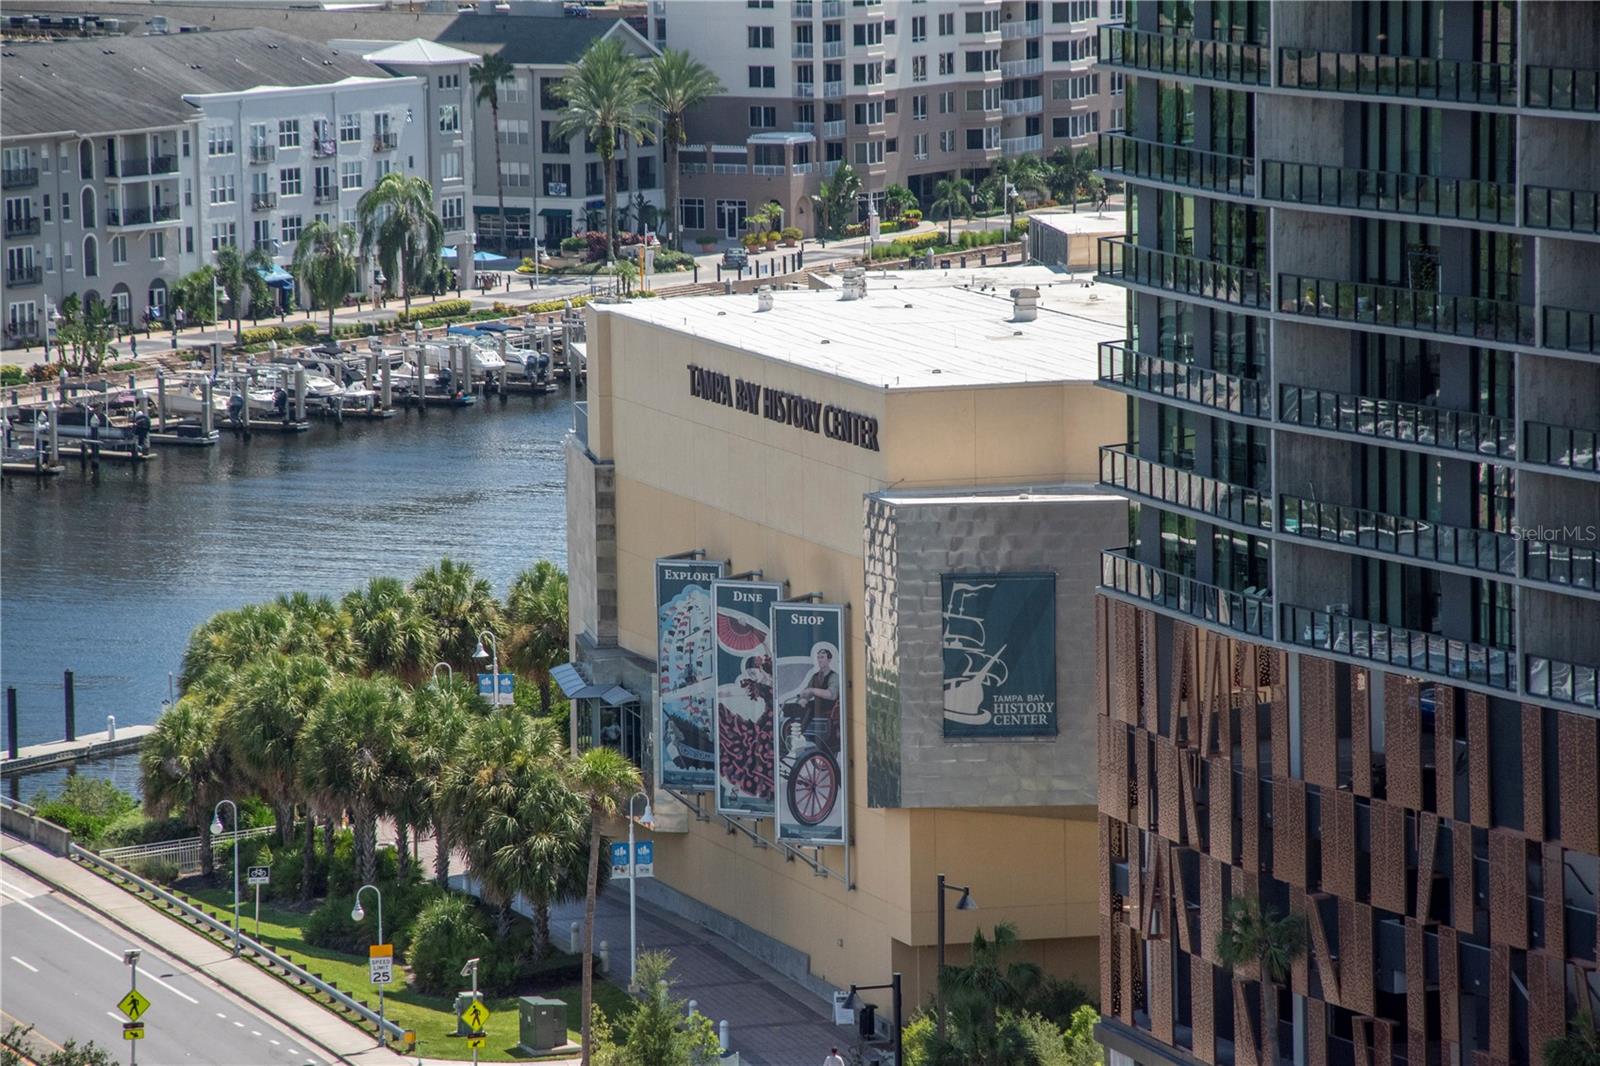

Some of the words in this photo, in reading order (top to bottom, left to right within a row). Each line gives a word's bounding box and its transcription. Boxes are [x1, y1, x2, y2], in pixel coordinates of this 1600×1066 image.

[687, 364, 733, 407] TAMPA
[735, 378, 761, 415] BAY
[763, 386, 822, 434] HISTORY
[823, 404, 880, 451] CENTER
[992, 694, 1023, 702] TAMPA
[1027, 694, 1045, 702] BAY
[993, 702, 1055, 714] HISTORY
[993, 714, 1049, 726] CENTER
[373, 971, 391, 983] 25
